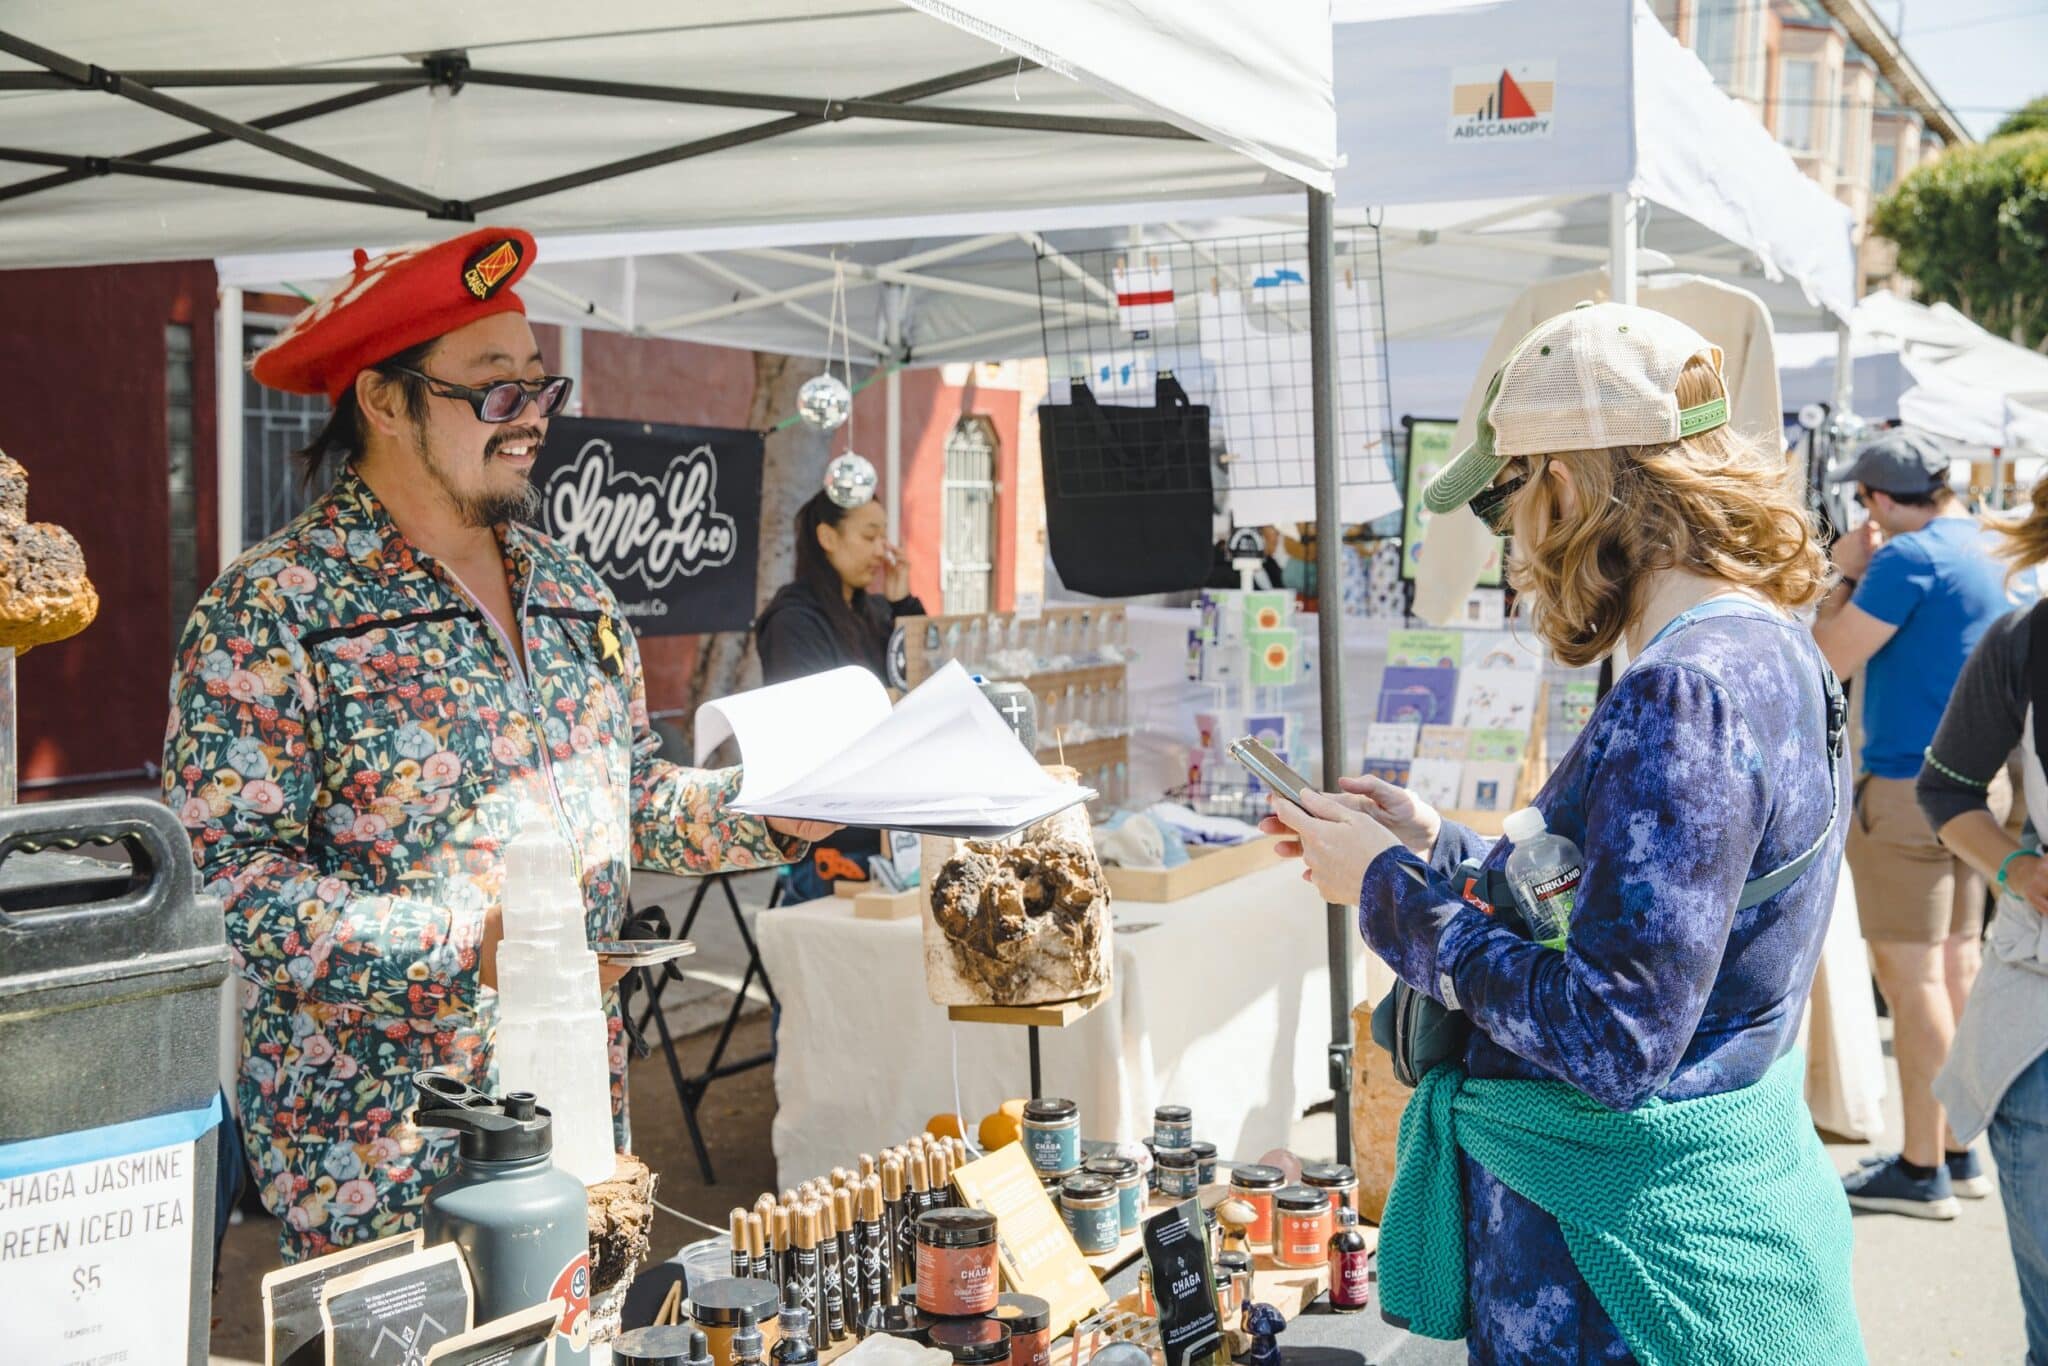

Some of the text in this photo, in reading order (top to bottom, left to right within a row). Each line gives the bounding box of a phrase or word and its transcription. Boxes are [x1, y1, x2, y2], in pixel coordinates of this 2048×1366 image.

[1454, 120, 1548, 139] ABCCANOPY
[465, 269, 487, 300] CHAGA
[1534, 867, 1581, 896] KIRKLAND
[1035, 1142, 1061, 1150] CHAGA
[85, 1149, 183, 1196] JASMINE
[1, 1199, 184, 1262] REEN ICED TEA
[72, 1264, 101, 1302] $5
[960, 1266, 993, 1280] CHAGA
[1172, 1272, 1201, 1296] CHAGA
